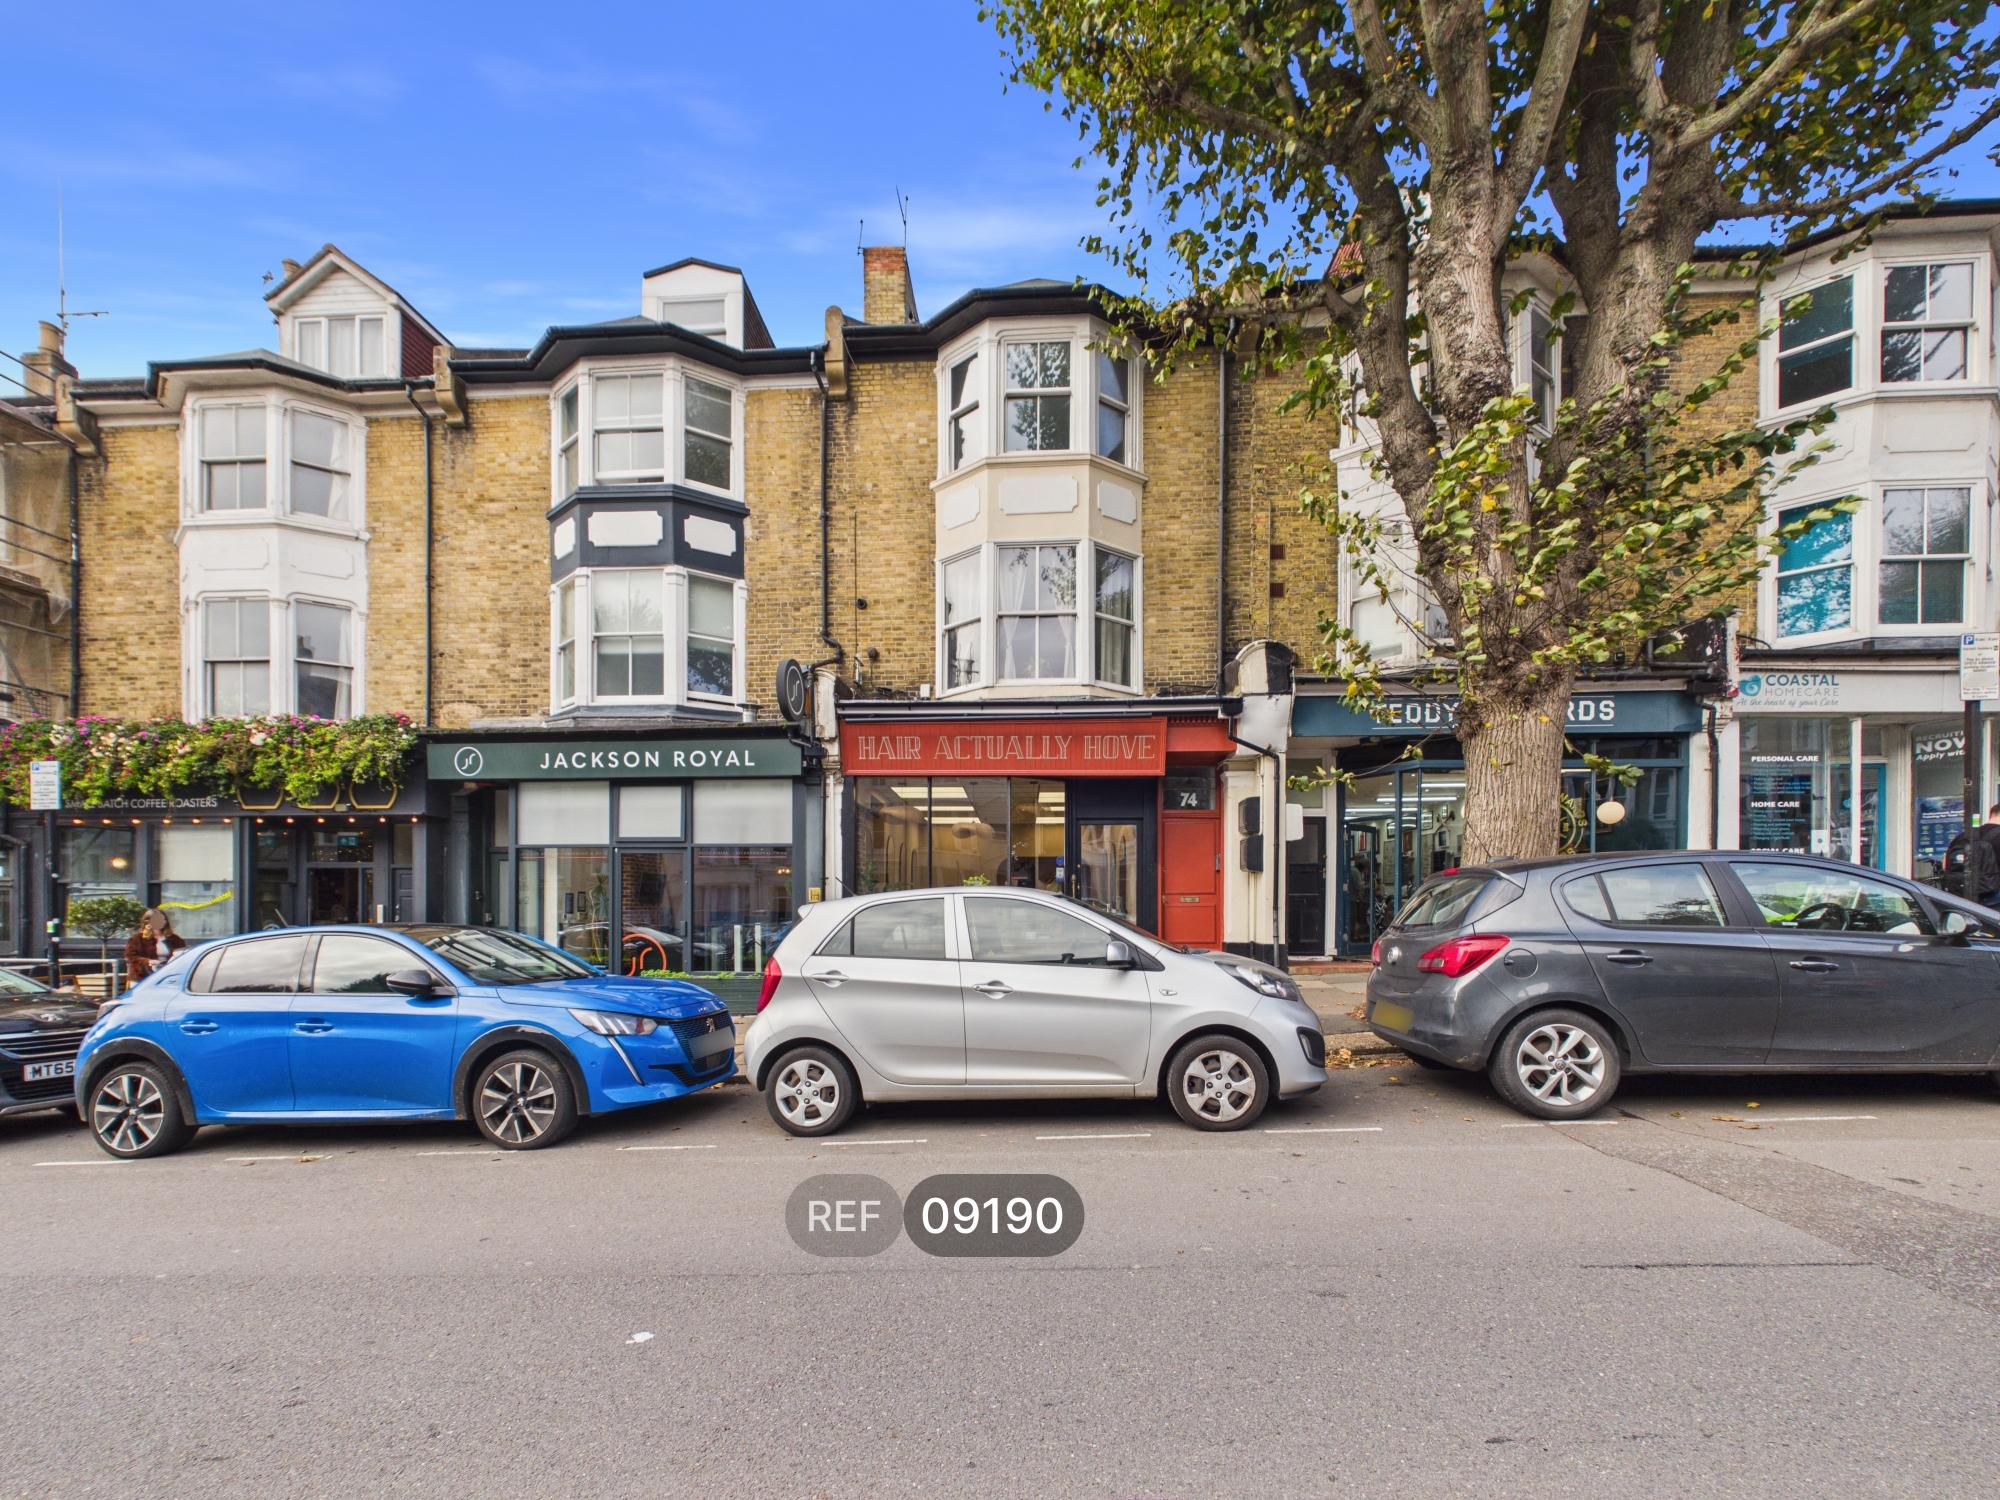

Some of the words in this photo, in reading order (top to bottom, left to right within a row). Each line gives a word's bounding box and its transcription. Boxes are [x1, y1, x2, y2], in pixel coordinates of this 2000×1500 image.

[1766, 674, 1839, 686] COASTAL
[1765, 687, 1839, 697] HOMECARE
[1750, 698, 1761, 706] the
[1764, 698, 1786, 706] heart
[1788, 698, 1796, 708] of
[1797, 699, 1818, 708] your
[1376, 702, 1460, 723] TEDDY
[858, 735, 921, 760] HAIR
[934, 735, 1072, 760] ACTUALLY
[1084, 735, 1155, 760] HOVE
[540, 751, 660, 769] JACKSON
[673, 750, 756, 768] ROYAL
[1916, 751, 1946, 762] Apply
[130, 798, 167, 809] COFFEE
[169, 798, 218, 808] ROASTERS
[1180, 792, 1198, 807] 74
[31, 1061, 74, 1077] MT65
